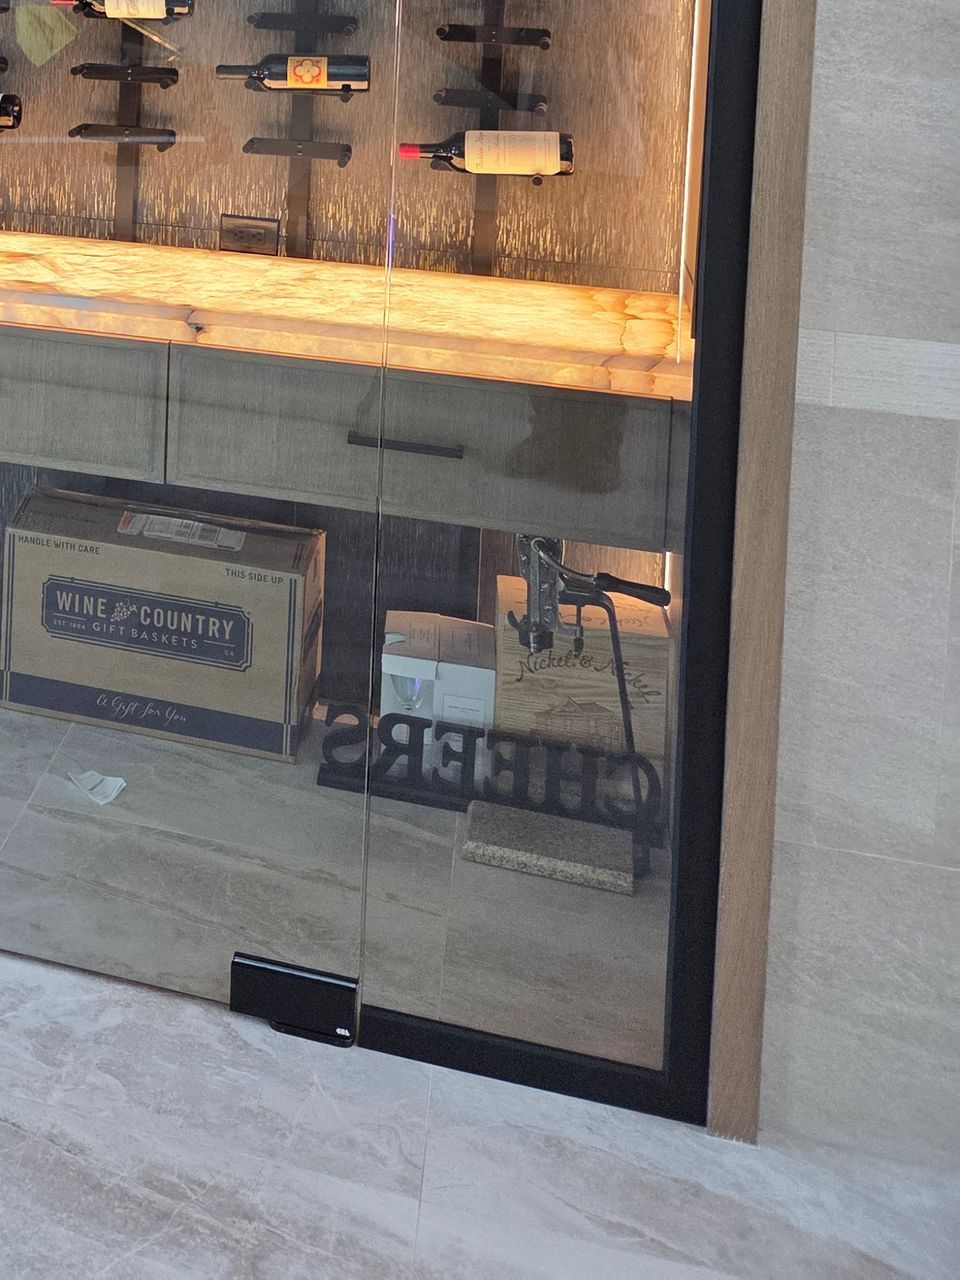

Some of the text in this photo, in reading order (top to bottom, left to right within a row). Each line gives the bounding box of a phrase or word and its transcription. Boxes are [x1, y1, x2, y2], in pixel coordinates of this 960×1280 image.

[18, 535, 101, 555] HANDLE WITH CARE
[225, 568, 283, 584] THIS SIDE UP
[56, 590, 234, 640] WINE COUNTRY
[92, 622, 198, 649] GIFT BASKETS
[516, 650, 575, 682] Nickel
[111, 696, 138, 719] Gift
[140, 702, 160, 719] for
[164, 706, 186, 727] You
